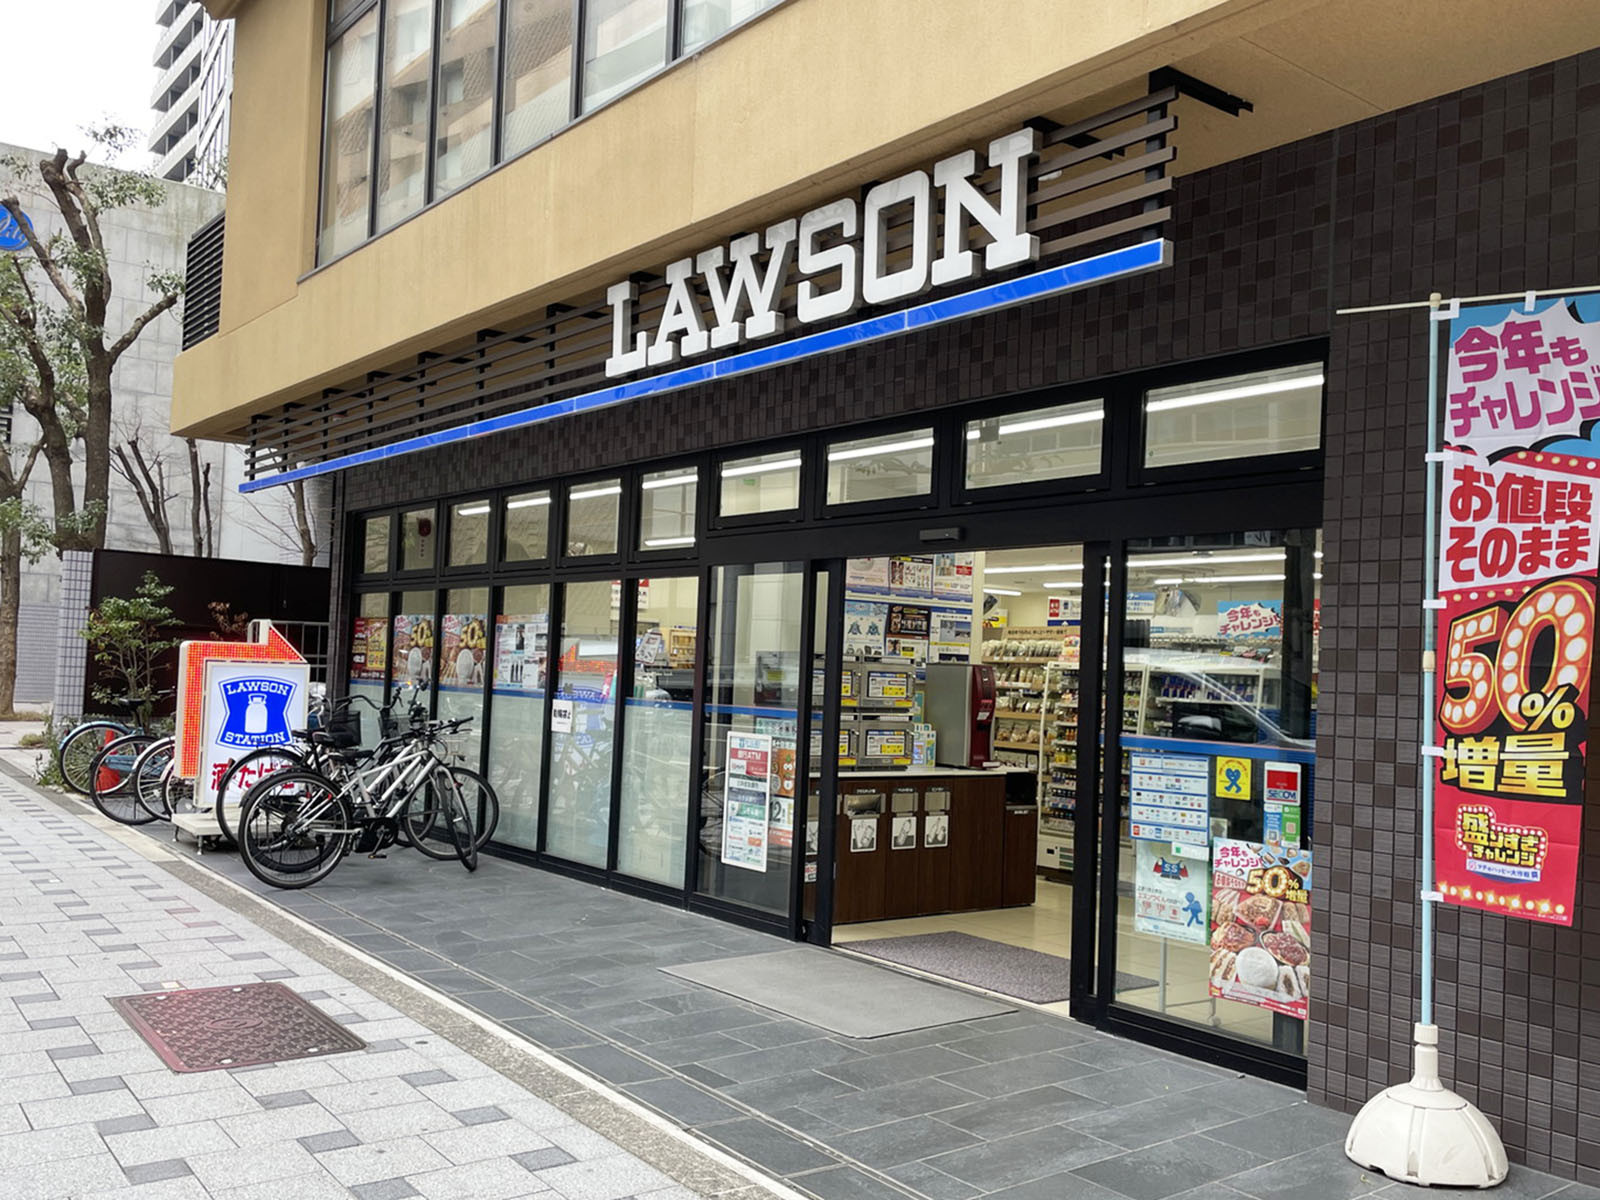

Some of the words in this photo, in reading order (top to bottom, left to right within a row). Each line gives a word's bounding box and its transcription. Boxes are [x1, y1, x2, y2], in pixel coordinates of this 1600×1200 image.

[605, 127, 1039, 377] LAWSON
[1454, 320, 1588, 383] 今年も
[1450, 365, 1600, 438] チャレンジ
[1450, 464, 1593, 524] お値段
[1446, 525, 1592, 583] そのまま
[1226, 606, 1261, 623] 今年も
[226, 681, 289, 696] LAWSON
[224, 731, 286, 746] STATION
[1442, 731, 1570, 797] 増量
[1268, 789, 1297, 800] SECOM
[1462, 812, 1539, 852] 盛りすぎ
[1220, 847, 1248, 858] 今年も
[1473, 844, 1535, 866] チャレンジ
